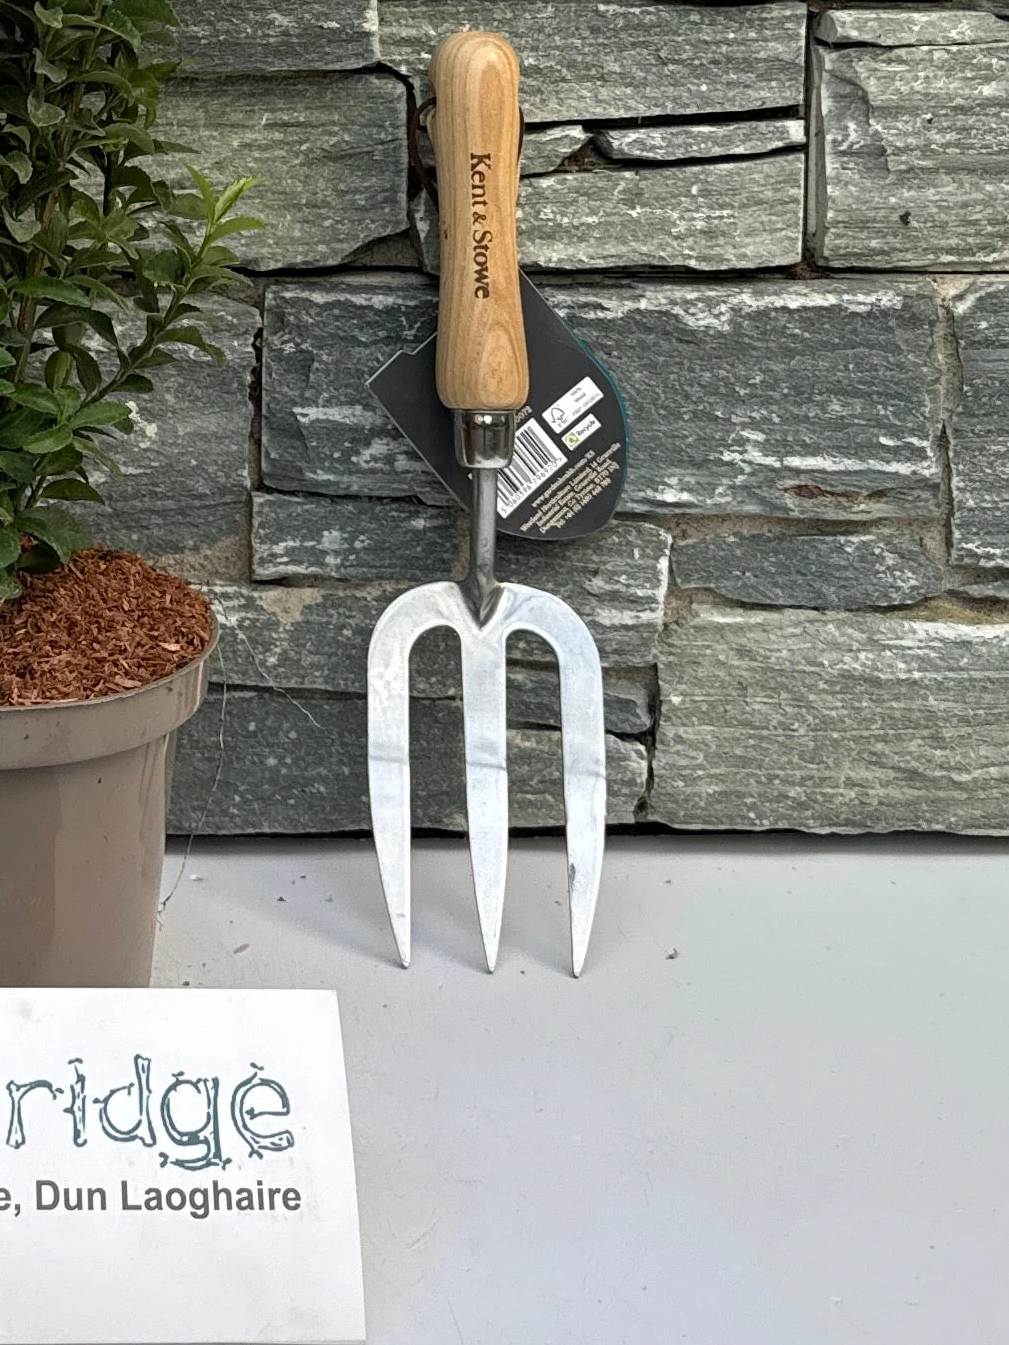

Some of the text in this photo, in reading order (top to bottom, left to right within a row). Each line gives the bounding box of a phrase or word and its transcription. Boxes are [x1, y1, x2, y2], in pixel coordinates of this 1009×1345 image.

[470, 152, 493, 299] Kent & Stowe
[35, 1180, 107, 1212] Dun
[122, 1179, 301, 1219] Laoghaire
